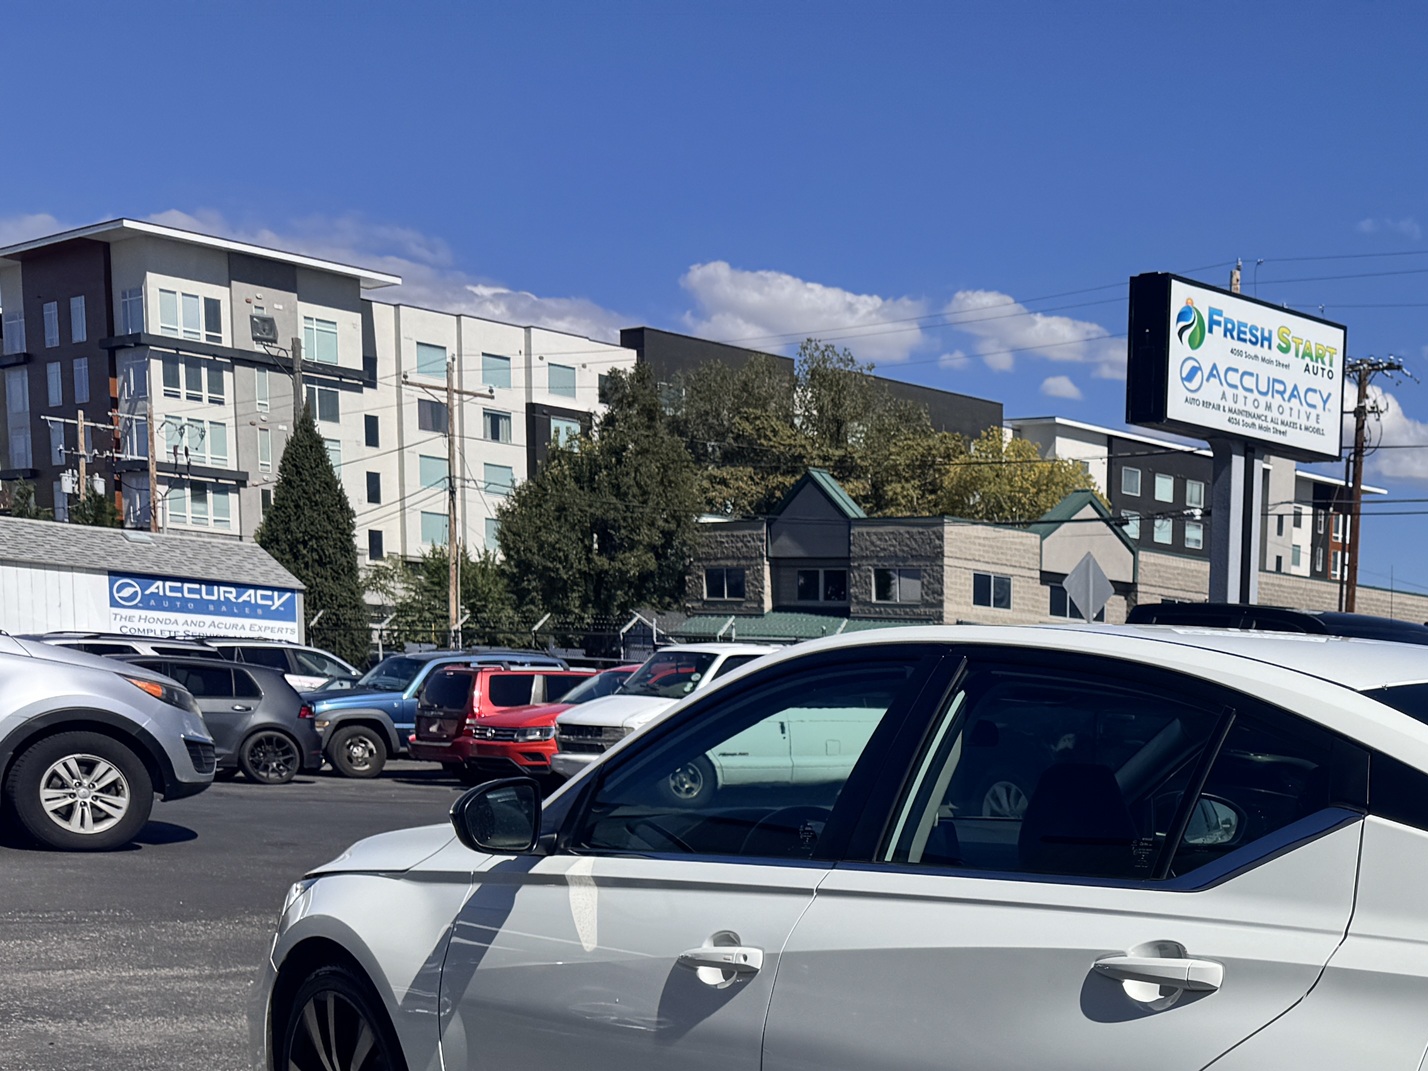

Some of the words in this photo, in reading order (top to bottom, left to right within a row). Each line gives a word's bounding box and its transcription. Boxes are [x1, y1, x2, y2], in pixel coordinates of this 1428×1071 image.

[1207, 306, 1273, 351] FRESH
[1276, 325, 1337, 368] START
[1244, 351, 1260, 362] South
[1260, 355, 1274, 366] Main
[1275, 359, 1290, 370] Street
[1303, 362, 1334, 380] AUTO
[1205, 362, 1332, 412] ACCURACY
[1184, 395, 1201, 407] AUTO
[1202, 400, 1221, 412] REPAIR
[1222, 405, 1226, 413] &
[1270, 416, 1279, 426] ALL
[1280, 419, 1298, 430] MAKES
[1220, 390, 1320, 424] AUTOMOTIVE
[1241, 419, 1257, 430] South
[1258, 423, 1271, 433] Main
[1272, 426, 1288, 437] Street
[144, 580, 292, 610] ACCURACY
[149, 600, 194, 609] AUTO
[208, 604, 263, 615] SALES
[112, 612, 136, 623] THE
[137, 612, 179, 626] HONDA
[182, 618, 206, 628] AND
[208, 620, 246, 631] ACURA
[248, 623, 297, 635] EXPERTS
[119, 625, 181, 637] COMPLETE
